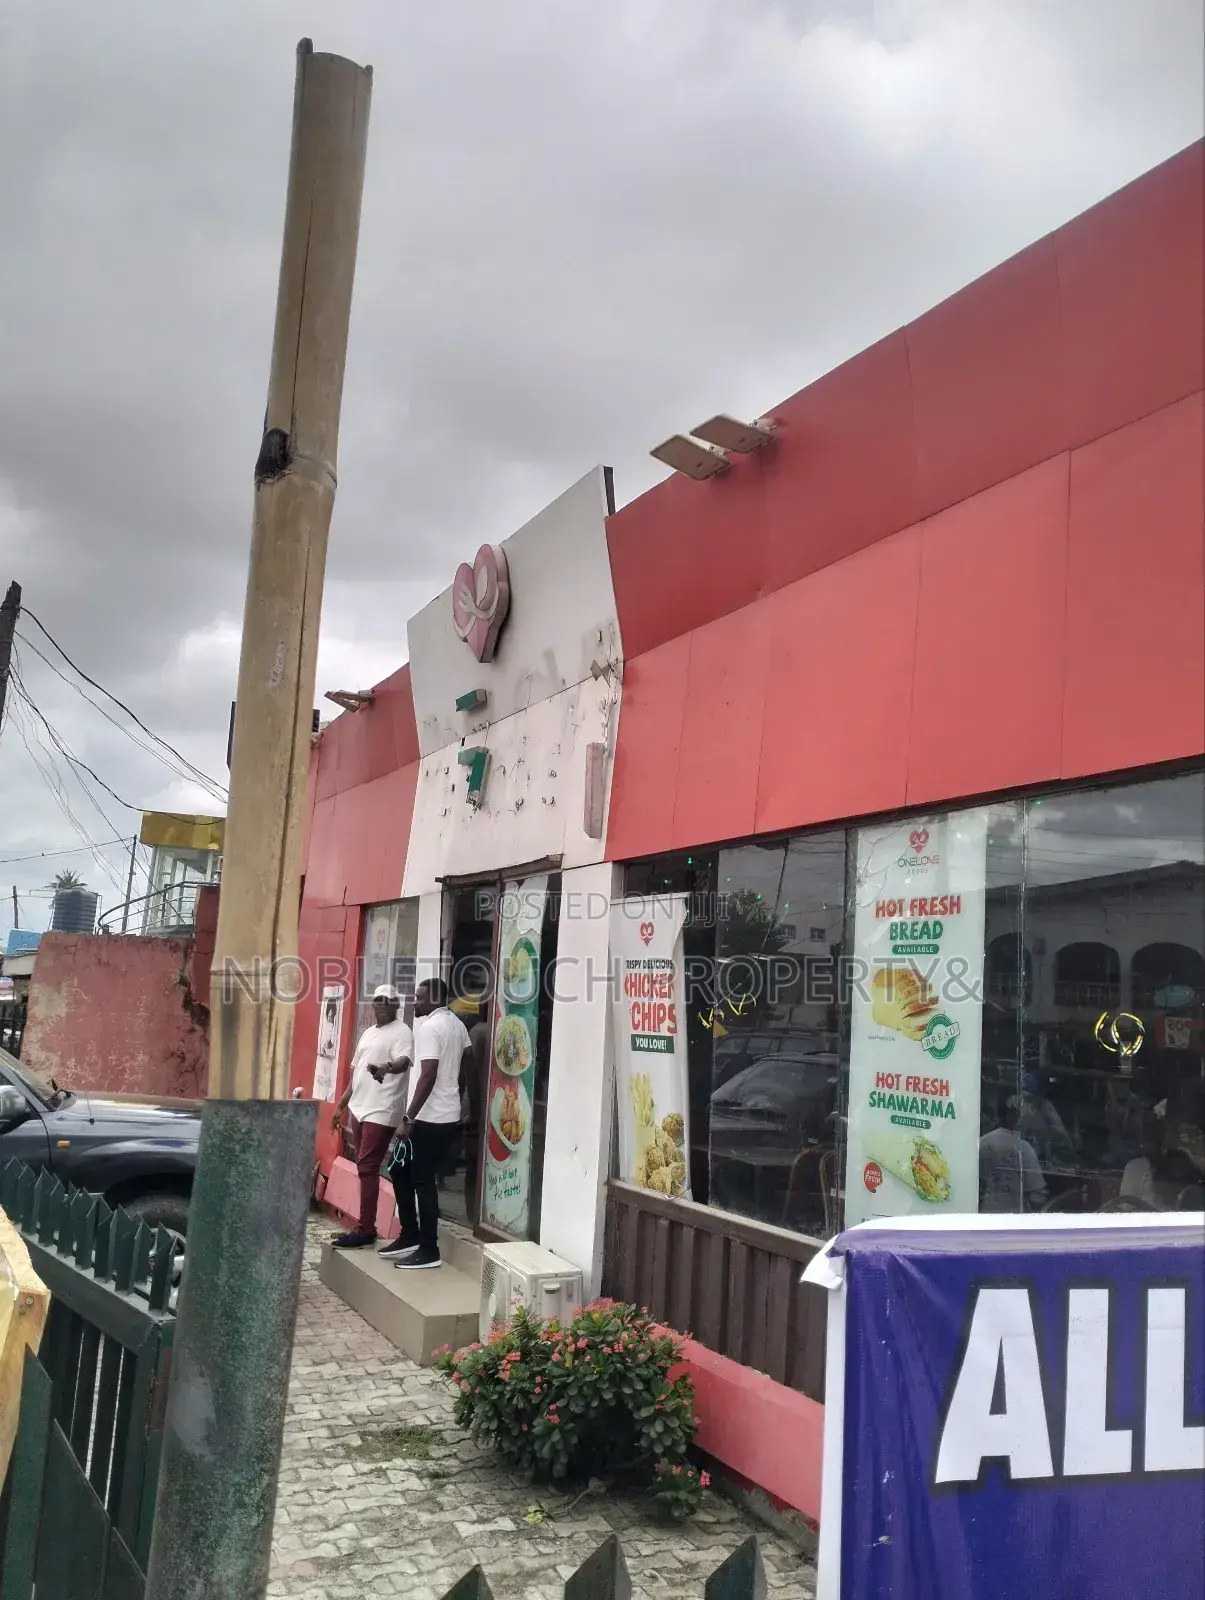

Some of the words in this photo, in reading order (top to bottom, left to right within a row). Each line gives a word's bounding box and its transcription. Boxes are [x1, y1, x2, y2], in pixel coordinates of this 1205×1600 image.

[897, 854, 940, 868] ONELOVE
[875, 898, 905, 918] HOT
[910, 895, 961, 917] FRESH
[889, 920, 944, 941] BREAD
[626, 959, 641, 969] RISPY
[643, 959, 673, 969] DELICIOUS
[631, 1001, 678, 1034] CHIPS
[635, 1037, 648, 1048] YOU
[649, 1038, 667, 1050] LOVE!
[925, 1027, 956, 1047] BREAD
[875, 1072, 902, 1090] HOT
[905, 1075, 950, 1096] FRESH
[868, 1091, 956, 1120] SHAWARMA
[895, 1116, 927, 1127] AVAILABLE
[935, 1288, 1205, 1484] ALL
